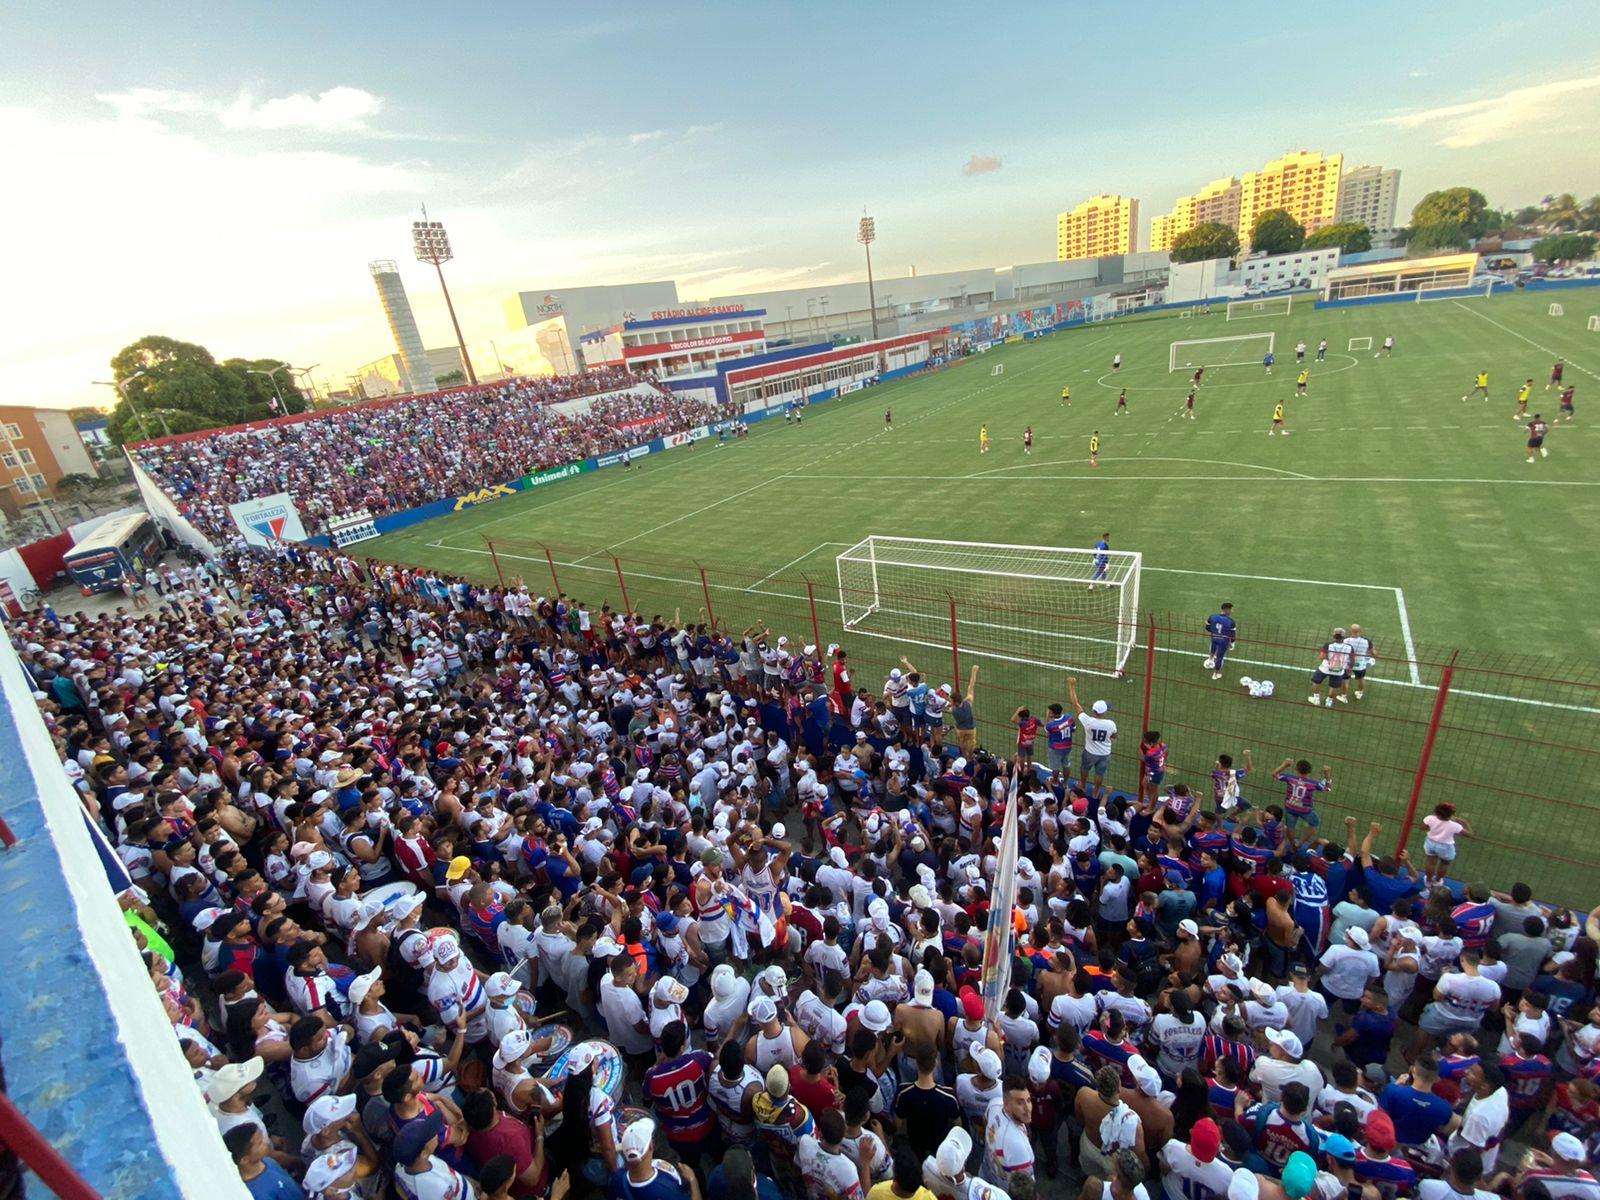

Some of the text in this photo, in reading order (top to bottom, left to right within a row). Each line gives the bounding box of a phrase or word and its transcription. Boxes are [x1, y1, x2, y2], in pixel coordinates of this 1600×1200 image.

[531, 468, 568, 486] Unimed
[245, 508, 285, 523] FORTALEZA
[1091, 729, 1107, 742] 18
[1292, 783, 1308, 799] 10
[664, 1080, 698, 1112] 10
